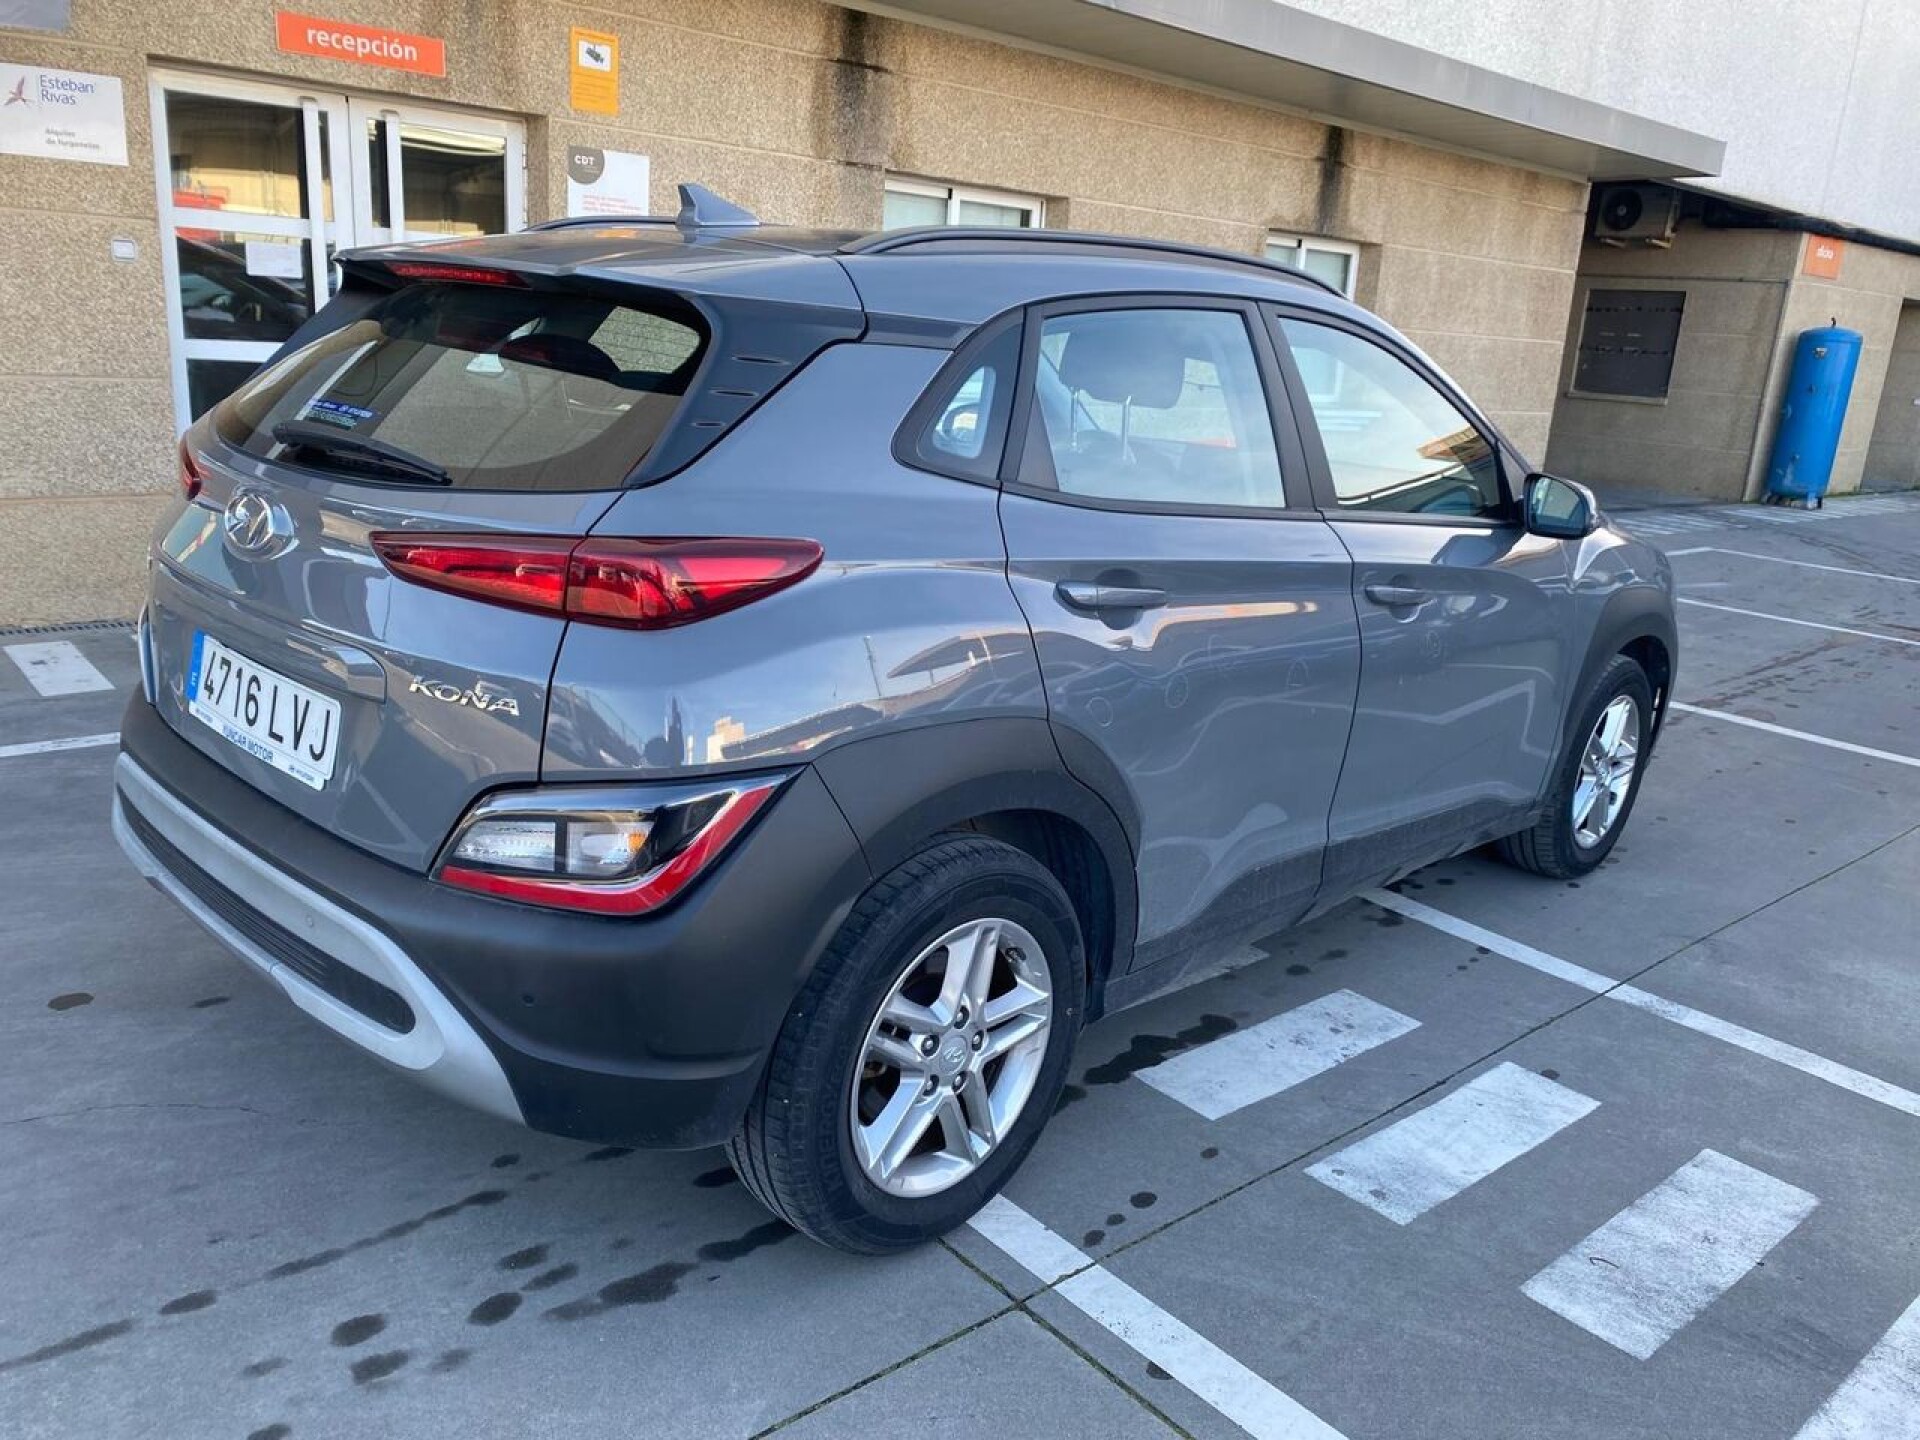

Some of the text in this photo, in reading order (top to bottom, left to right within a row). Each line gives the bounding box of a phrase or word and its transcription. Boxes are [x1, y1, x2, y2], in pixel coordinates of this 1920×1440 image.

[306, 28, 418, 61] recepción
[40, 74, 95, 94] Esteban
[41, 89, 77, 106] Rivas
[574, 154, 596, 166] CDT
[203, 650, 331, 761] 4716 LVJ
[408, 675, 520, 716] KONA
[247, 739, 274, 763] MOTOR
